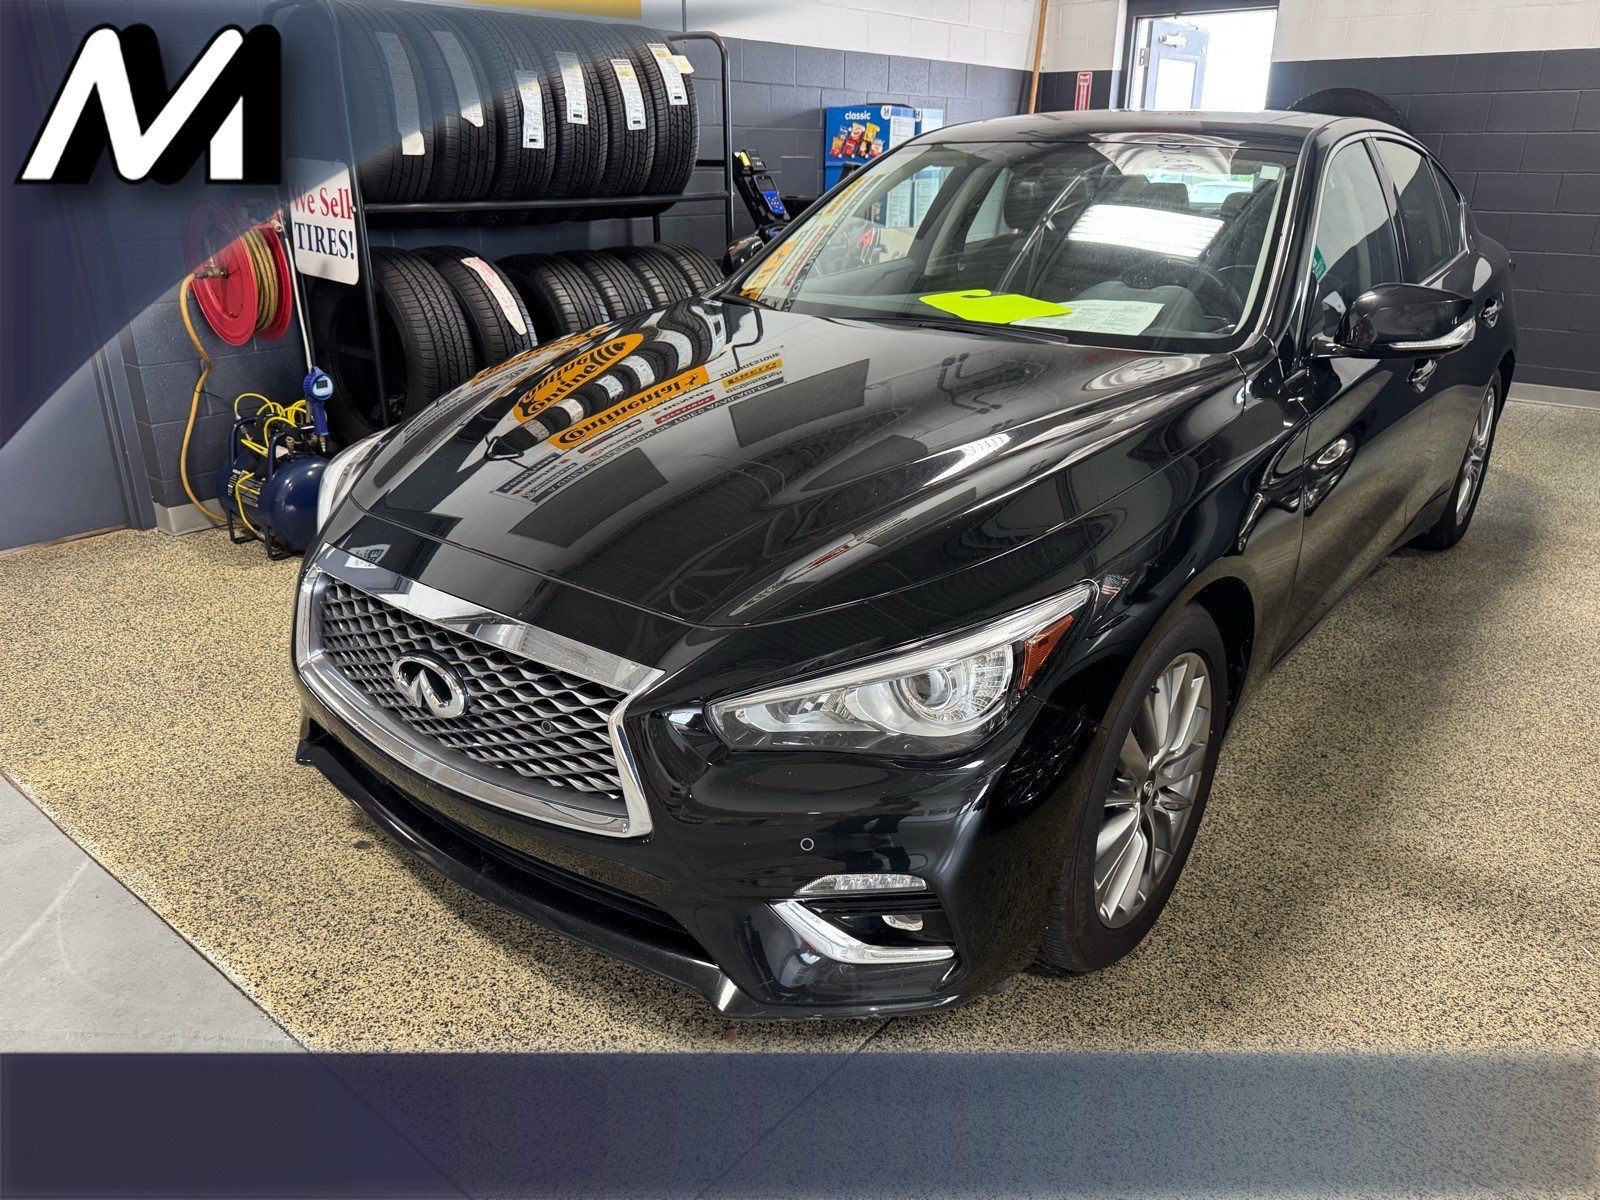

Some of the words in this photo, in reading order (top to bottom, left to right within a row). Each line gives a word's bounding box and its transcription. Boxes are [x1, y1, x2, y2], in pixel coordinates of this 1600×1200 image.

[845, 110, 871, 120] classic
[290, 184, 315, 214] We
[320, 187, 353, 220] Sell
[294, 221, 355, 260] TIRES!
